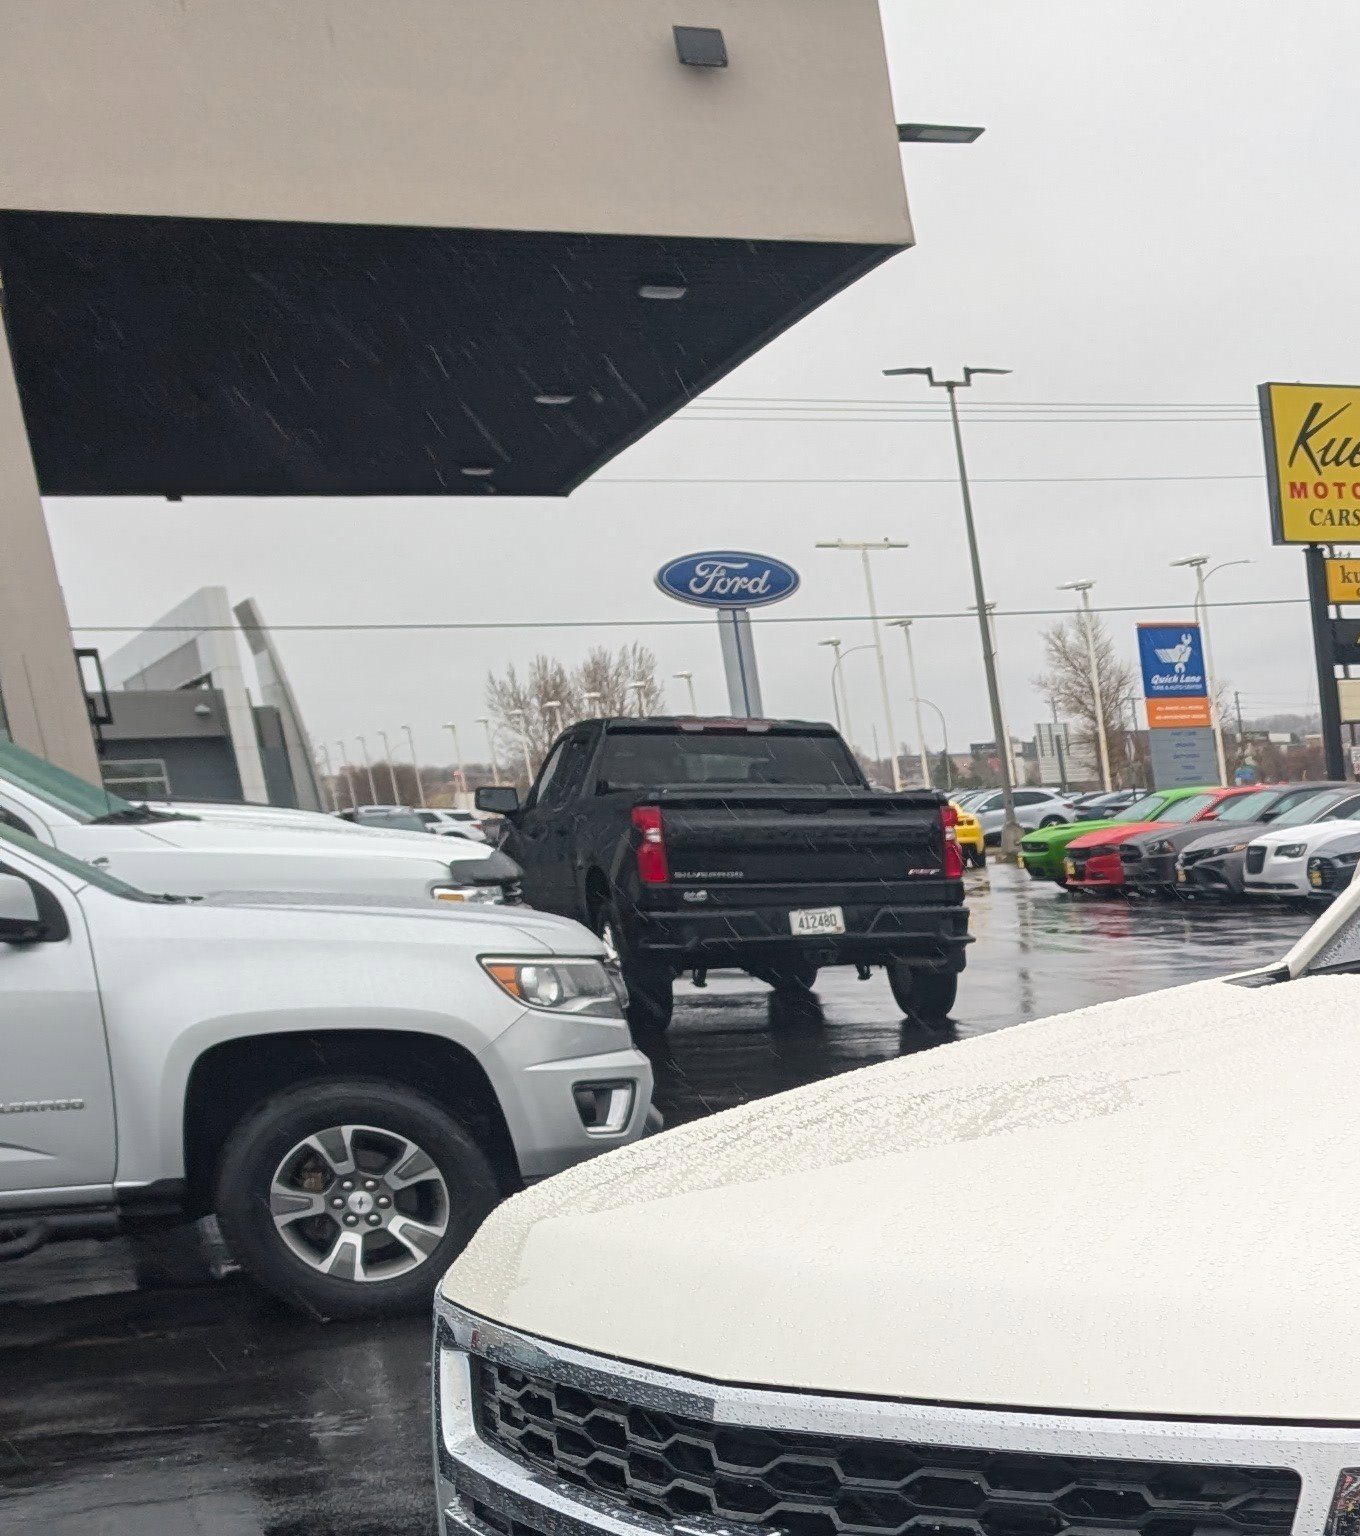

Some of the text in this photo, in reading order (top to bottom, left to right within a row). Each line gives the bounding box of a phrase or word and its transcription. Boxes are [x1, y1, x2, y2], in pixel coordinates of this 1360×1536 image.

[688, 560, 771, 595] Ford
[1151, 674, 1201, 685] Quick Lane
